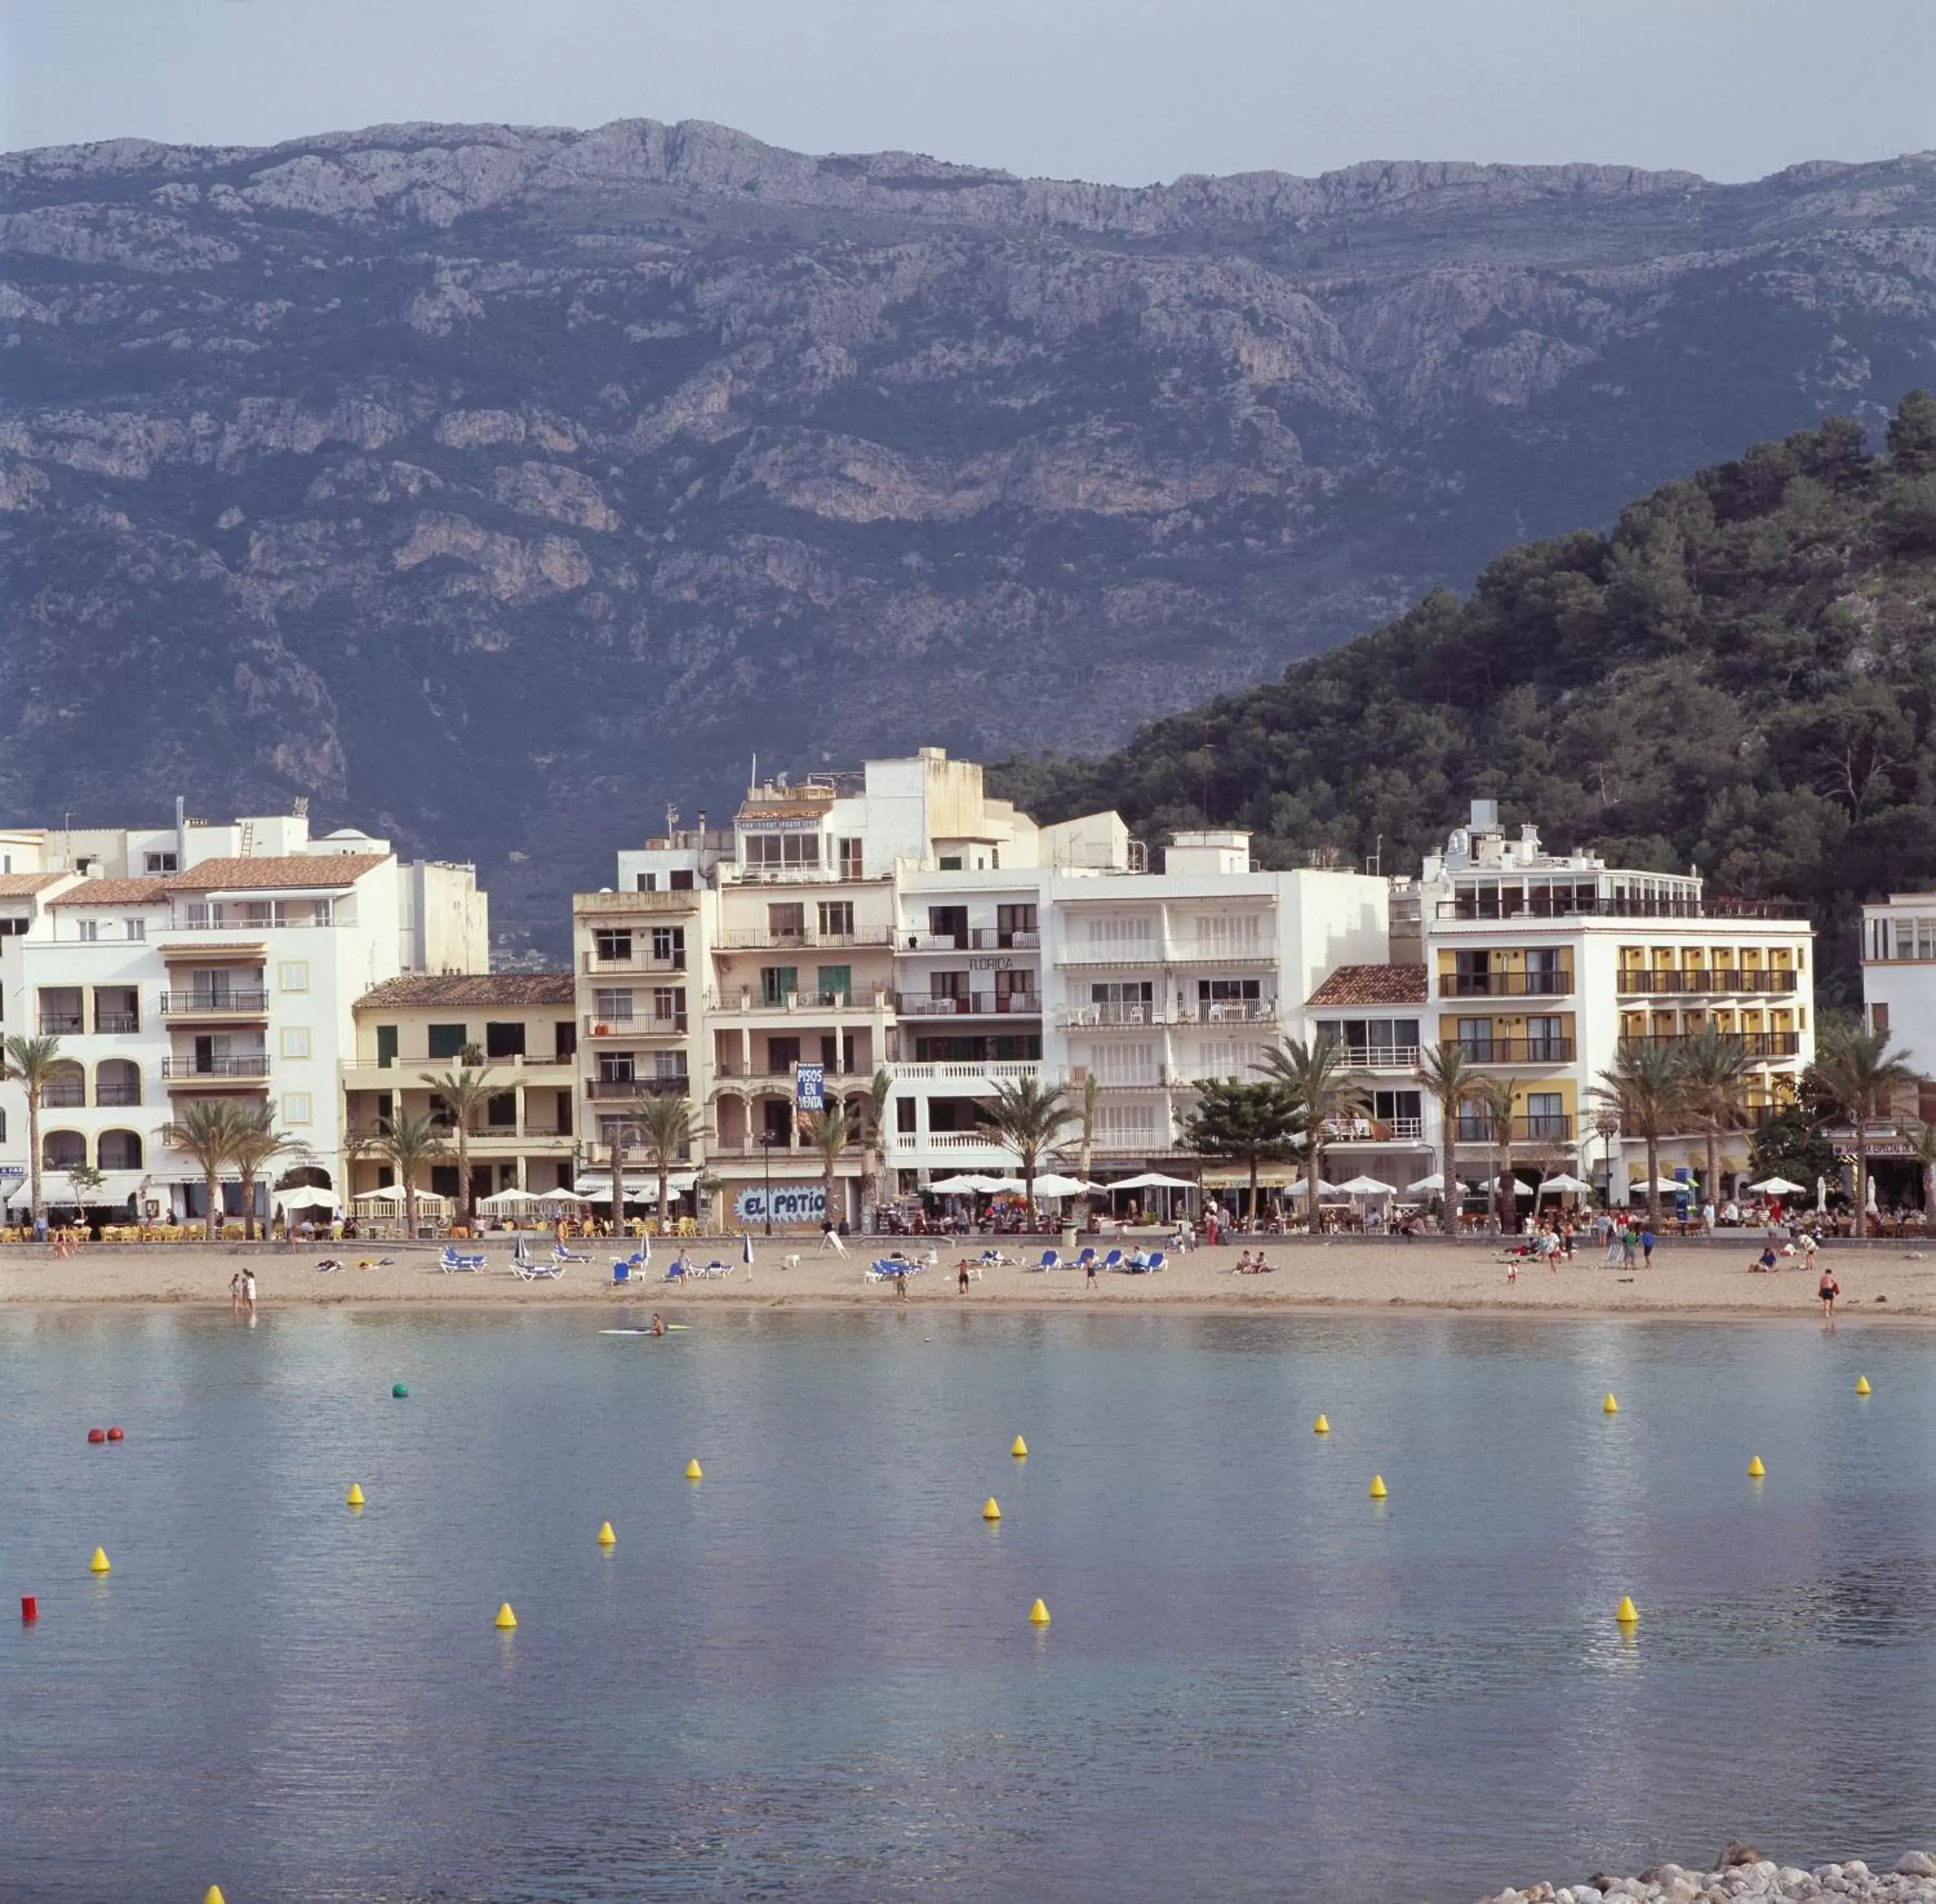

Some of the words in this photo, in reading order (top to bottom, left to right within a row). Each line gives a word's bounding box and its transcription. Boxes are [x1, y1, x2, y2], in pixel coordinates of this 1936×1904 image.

[970, 957, 1013, 971] FLORIDA
[798, 1069, 823, 1082] PISOS
[804, 1082, 816, 1095] EN
[798, 1096, 823, 1109] VENTA
[745, 1197, 765, 1215] EL
